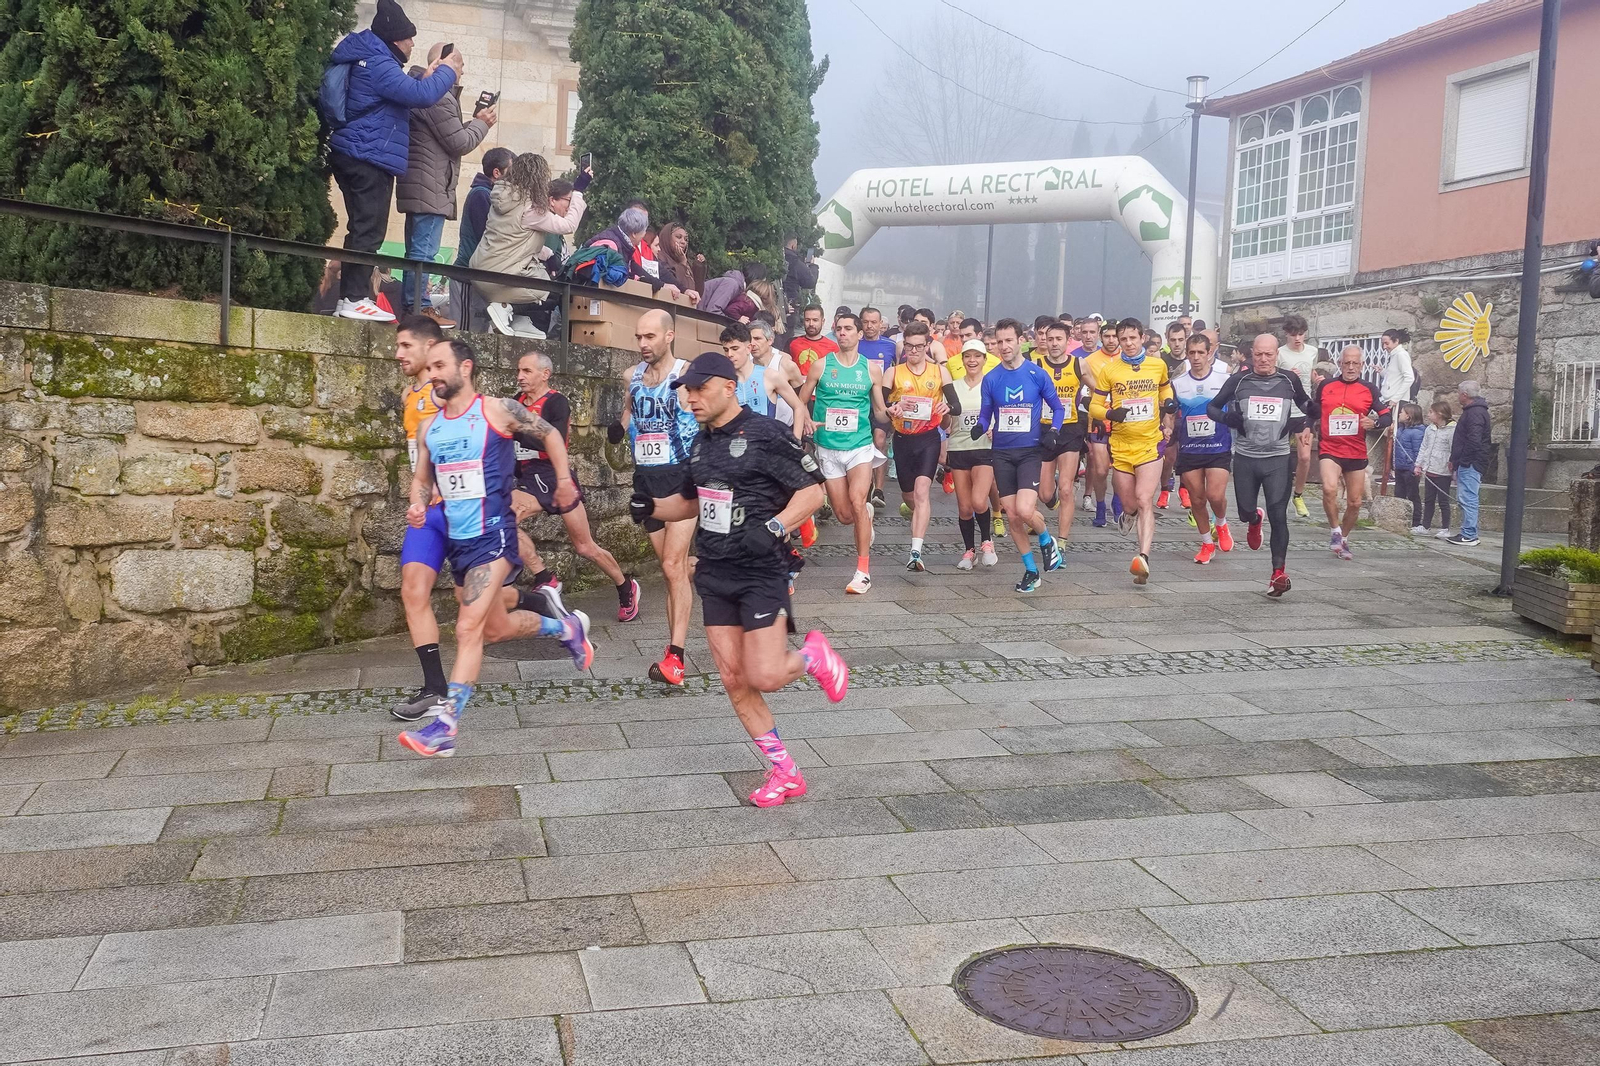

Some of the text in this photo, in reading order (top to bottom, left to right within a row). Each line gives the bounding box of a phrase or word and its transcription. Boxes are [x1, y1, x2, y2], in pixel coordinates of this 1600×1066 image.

[866, 177, 934, 198] HOTEL
[948, 175, 973, 195] LA
[867, 198, 995, 214] www.hotelrectoral.com
[1130, 405, 1148, 416] 114
[1256, 404, 1276, 415] 159
[835, 416, 848, 426] 65
[963, 415, 979, 426] 65
[1007, 415, 1020, 425] 84
[1335, 420, 1353, 430] 157
[1192, 421, 1210, 432] 172
[642, 443, 661, 456] 103
[449, 474, 466, 491] 91
[703, 501, 716, 520] 68
